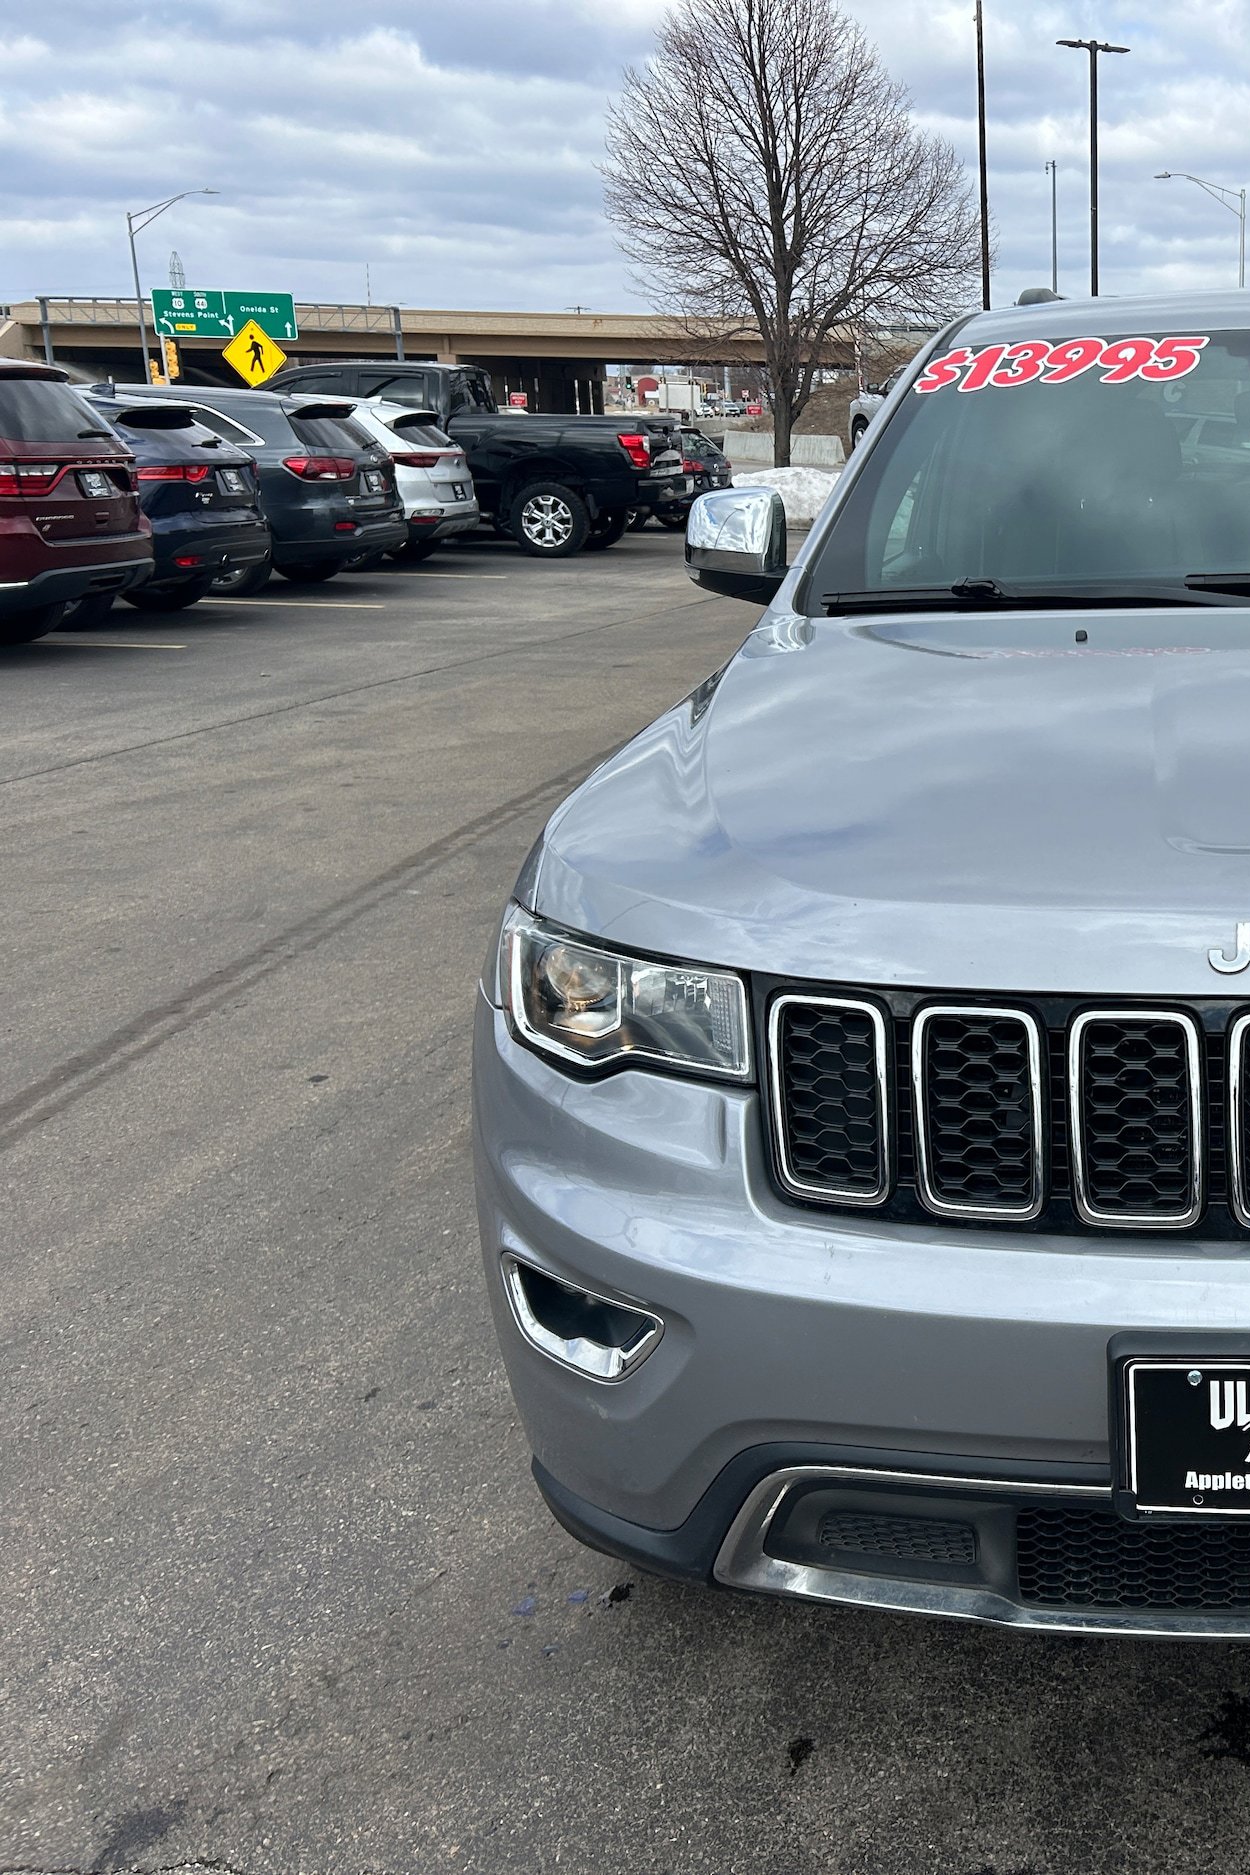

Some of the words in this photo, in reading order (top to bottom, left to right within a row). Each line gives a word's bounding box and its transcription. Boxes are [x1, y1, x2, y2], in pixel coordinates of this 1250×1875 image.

[239, 305, 267, 314] Oneida
[269, 306, 279, 314] St
[163, 310, 195, 318] Stevens
[197, 311, 219, 319] Point
[913, 336, 1210, 393] $13995
